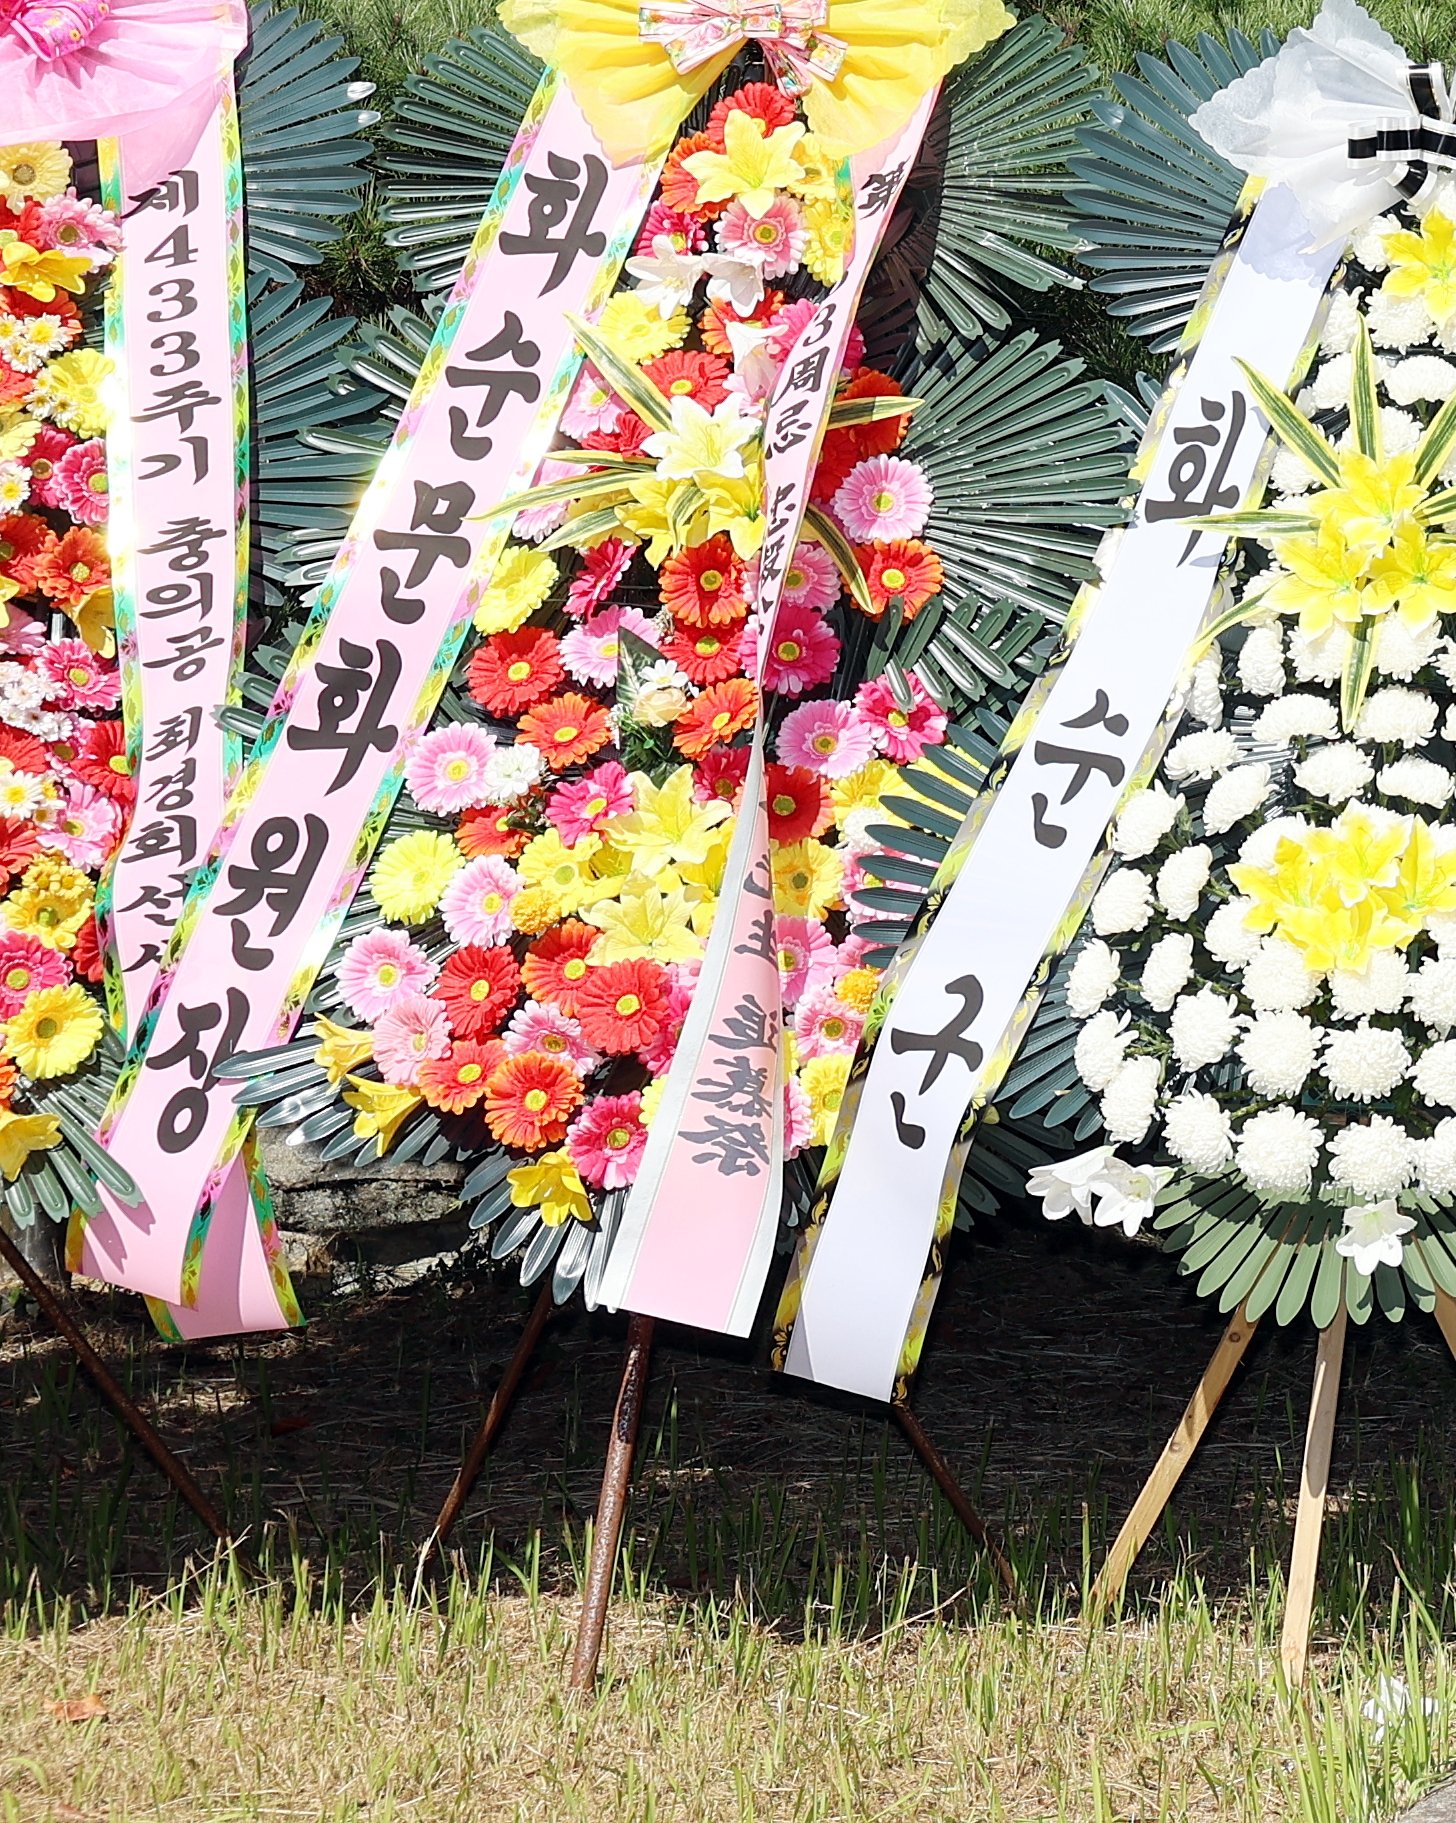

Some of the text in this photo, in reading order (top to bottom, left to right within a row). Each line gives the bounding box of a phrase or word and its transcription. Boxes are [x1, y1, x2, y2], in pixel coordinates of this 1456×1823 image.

[120, 170, 223, 485] 제433주기
[137, 517, 227, 681] 충의공
[147, 152, 606, 1154] 화순문화원장
[121, 706, 203, 867] 최경회
[891, 389, 1247, 1152] 화순군
